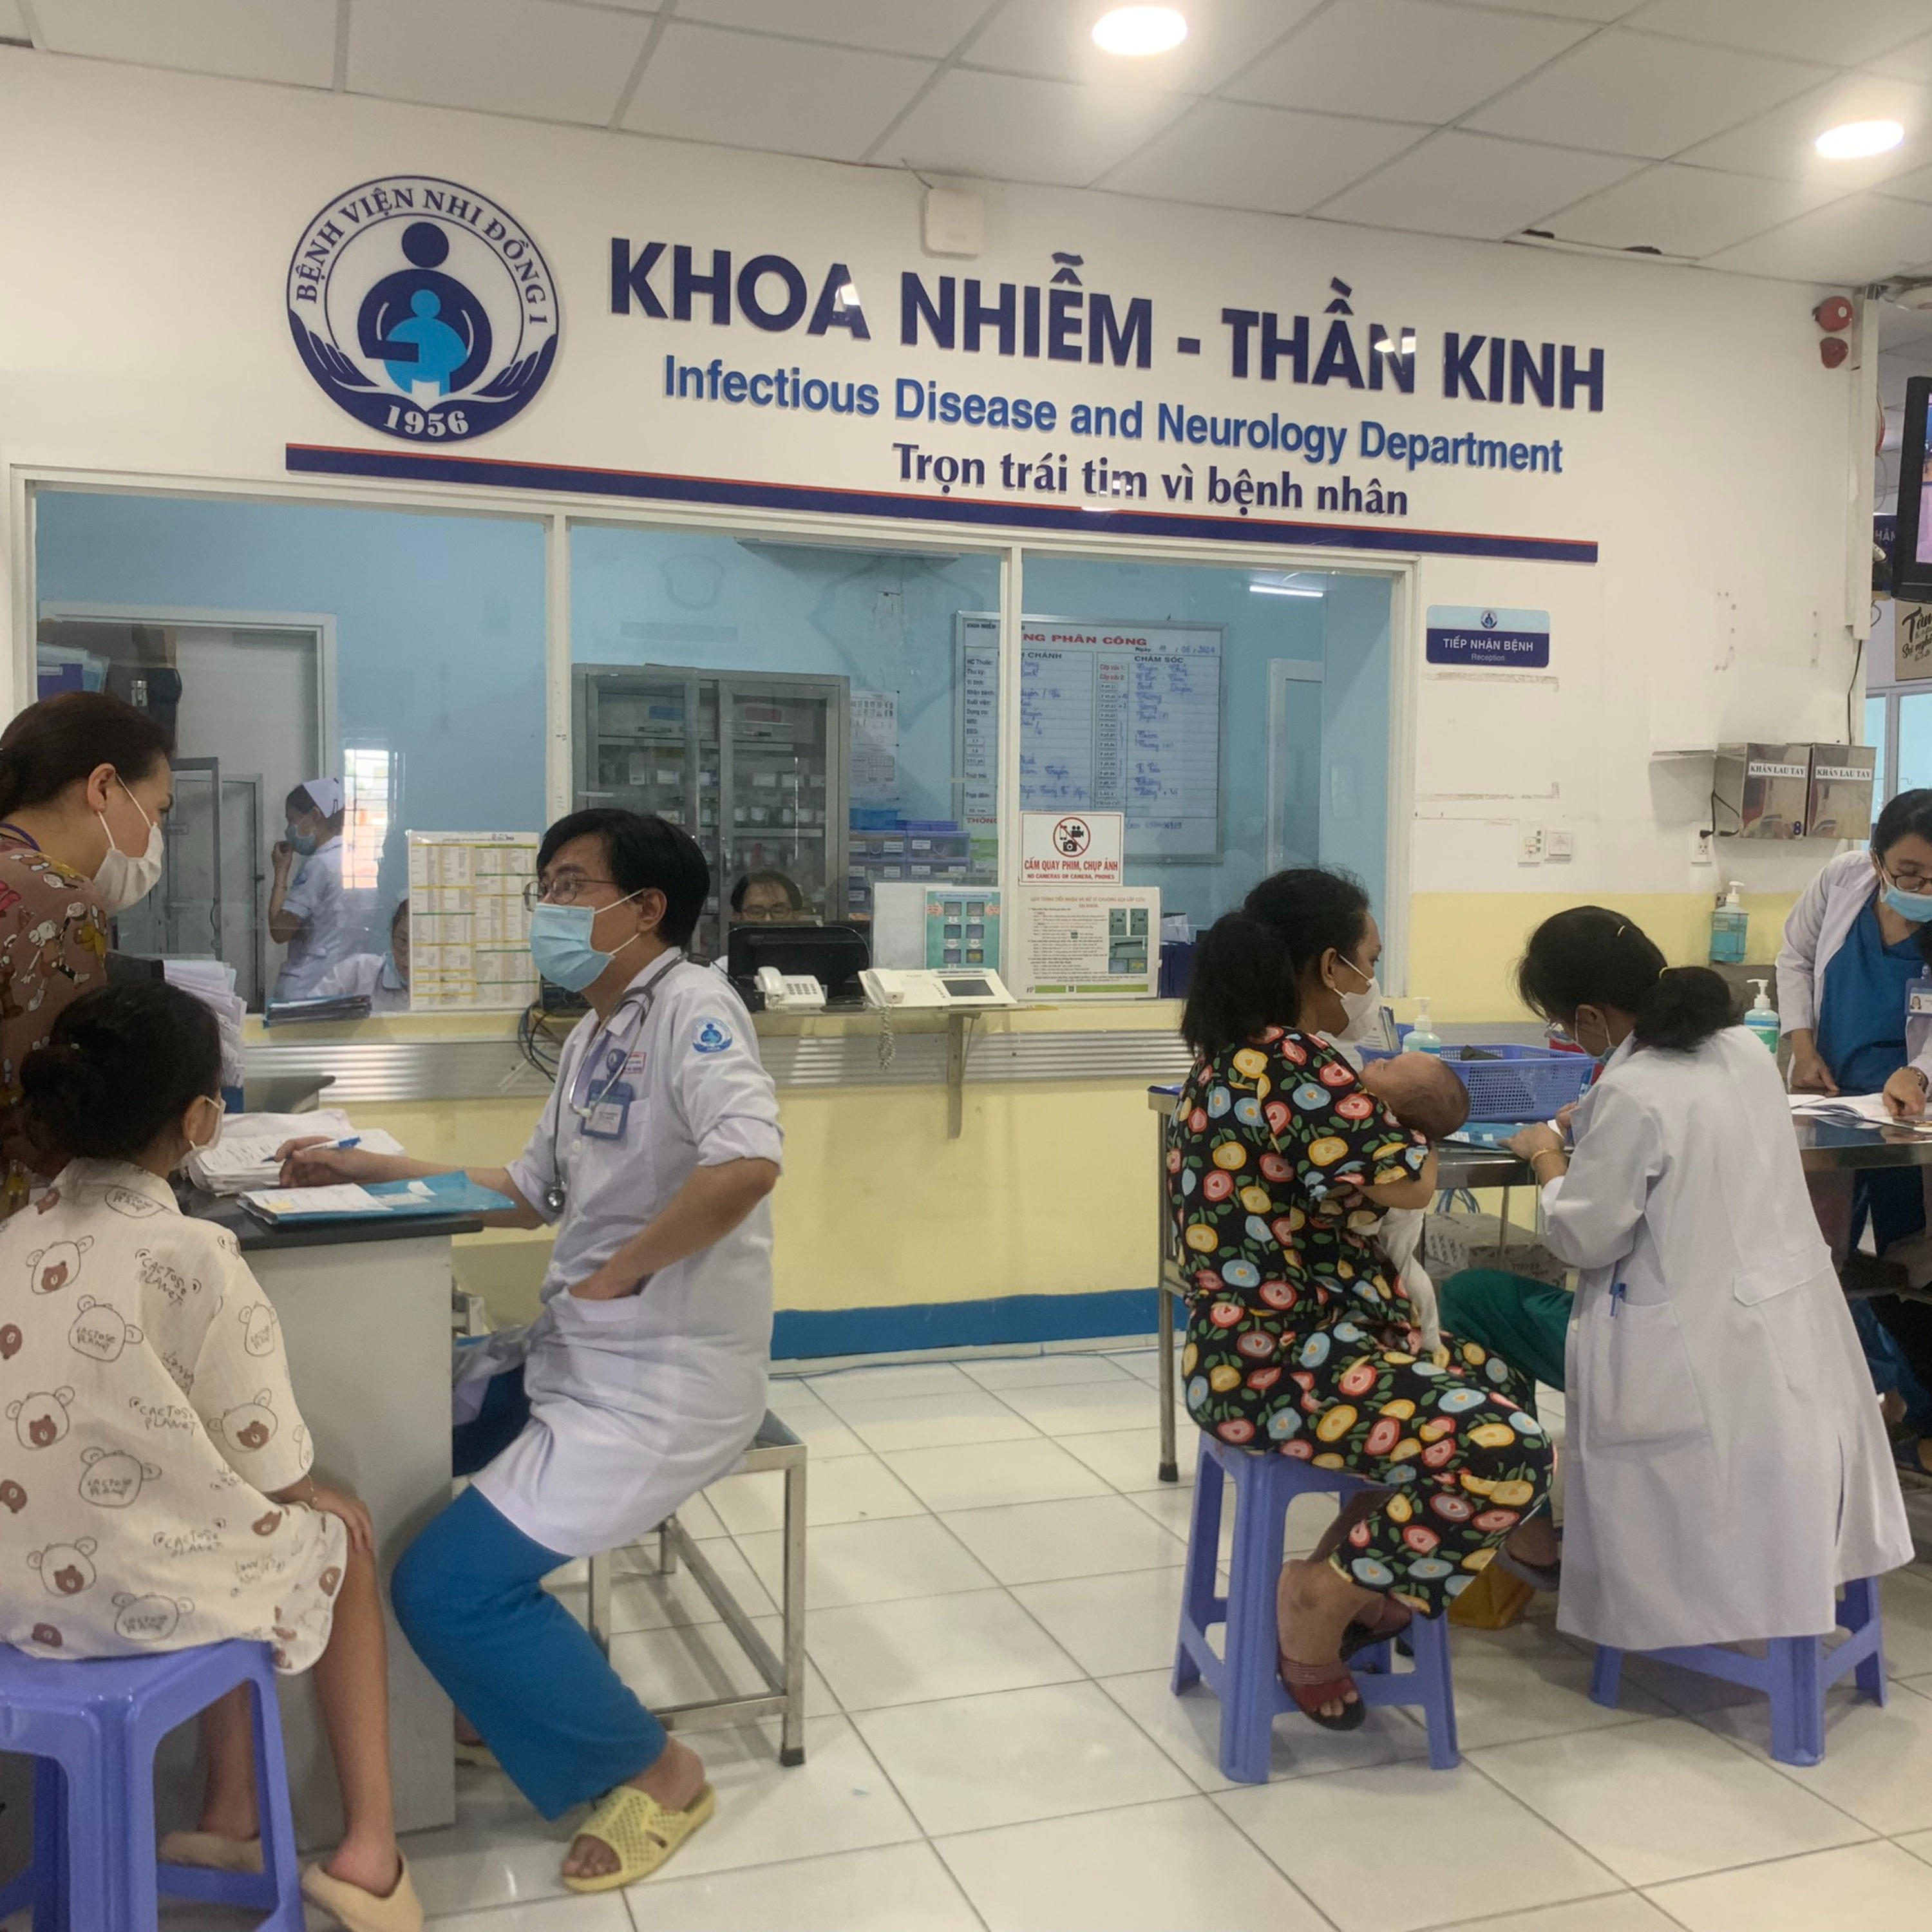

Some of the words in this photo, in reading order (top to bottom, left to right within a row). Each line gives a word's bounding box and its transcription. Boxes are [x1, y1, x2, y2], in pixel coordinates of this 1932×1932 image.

[296, 220, 345, 305] BỆNH
[339, 187, 414, 216] VIỆN
[424, 189, 482, 227] NHI
[611, 238, 870, 339] KHOA
[901, 252, 1152, 368] NHIỄM
[1222, 277, 1416, 393] THẦN
[1443, 332, 1604, 412] KINH
[383, 405, 469, 437] 1956
[665, 355, 879, 415] Infectious
[895, 378, 1057, 432] Disease
[1071, 401, 1142, 439] and
[1159, 403, 1347, 464] Neurology
[1360, 421, 1562, 473] Department
[893, 443, 985, 493] Trọn
[1001, 453, 1067, 492] trái
[1083, 457, 1147, 498] tim
[1162, 464, 1193, 501] vì
[1208, 466, 1302, 516] bệnh
[1317, 477, 1408, 516] nhân
[1023, 634, 1046, 642] NG
[1052, 634, 1097, 644] PHÂN
[1102, 636, 1147, 646] CÔNG
[1443, 635, 1467, 649] TIẾP
[1470, 638, 1501, 652] NHẬN
[1504, 639, 1533, 653] BỆNH
[1471, 653, 1505, 662] Reception
[1024, 857, 1039, 869] CẤM
[1041, 860, 1060, 871] QUAY
[1062, 860, 1081, 872] PHIM,
[1083, 860, 1103, 873] CHỤP
